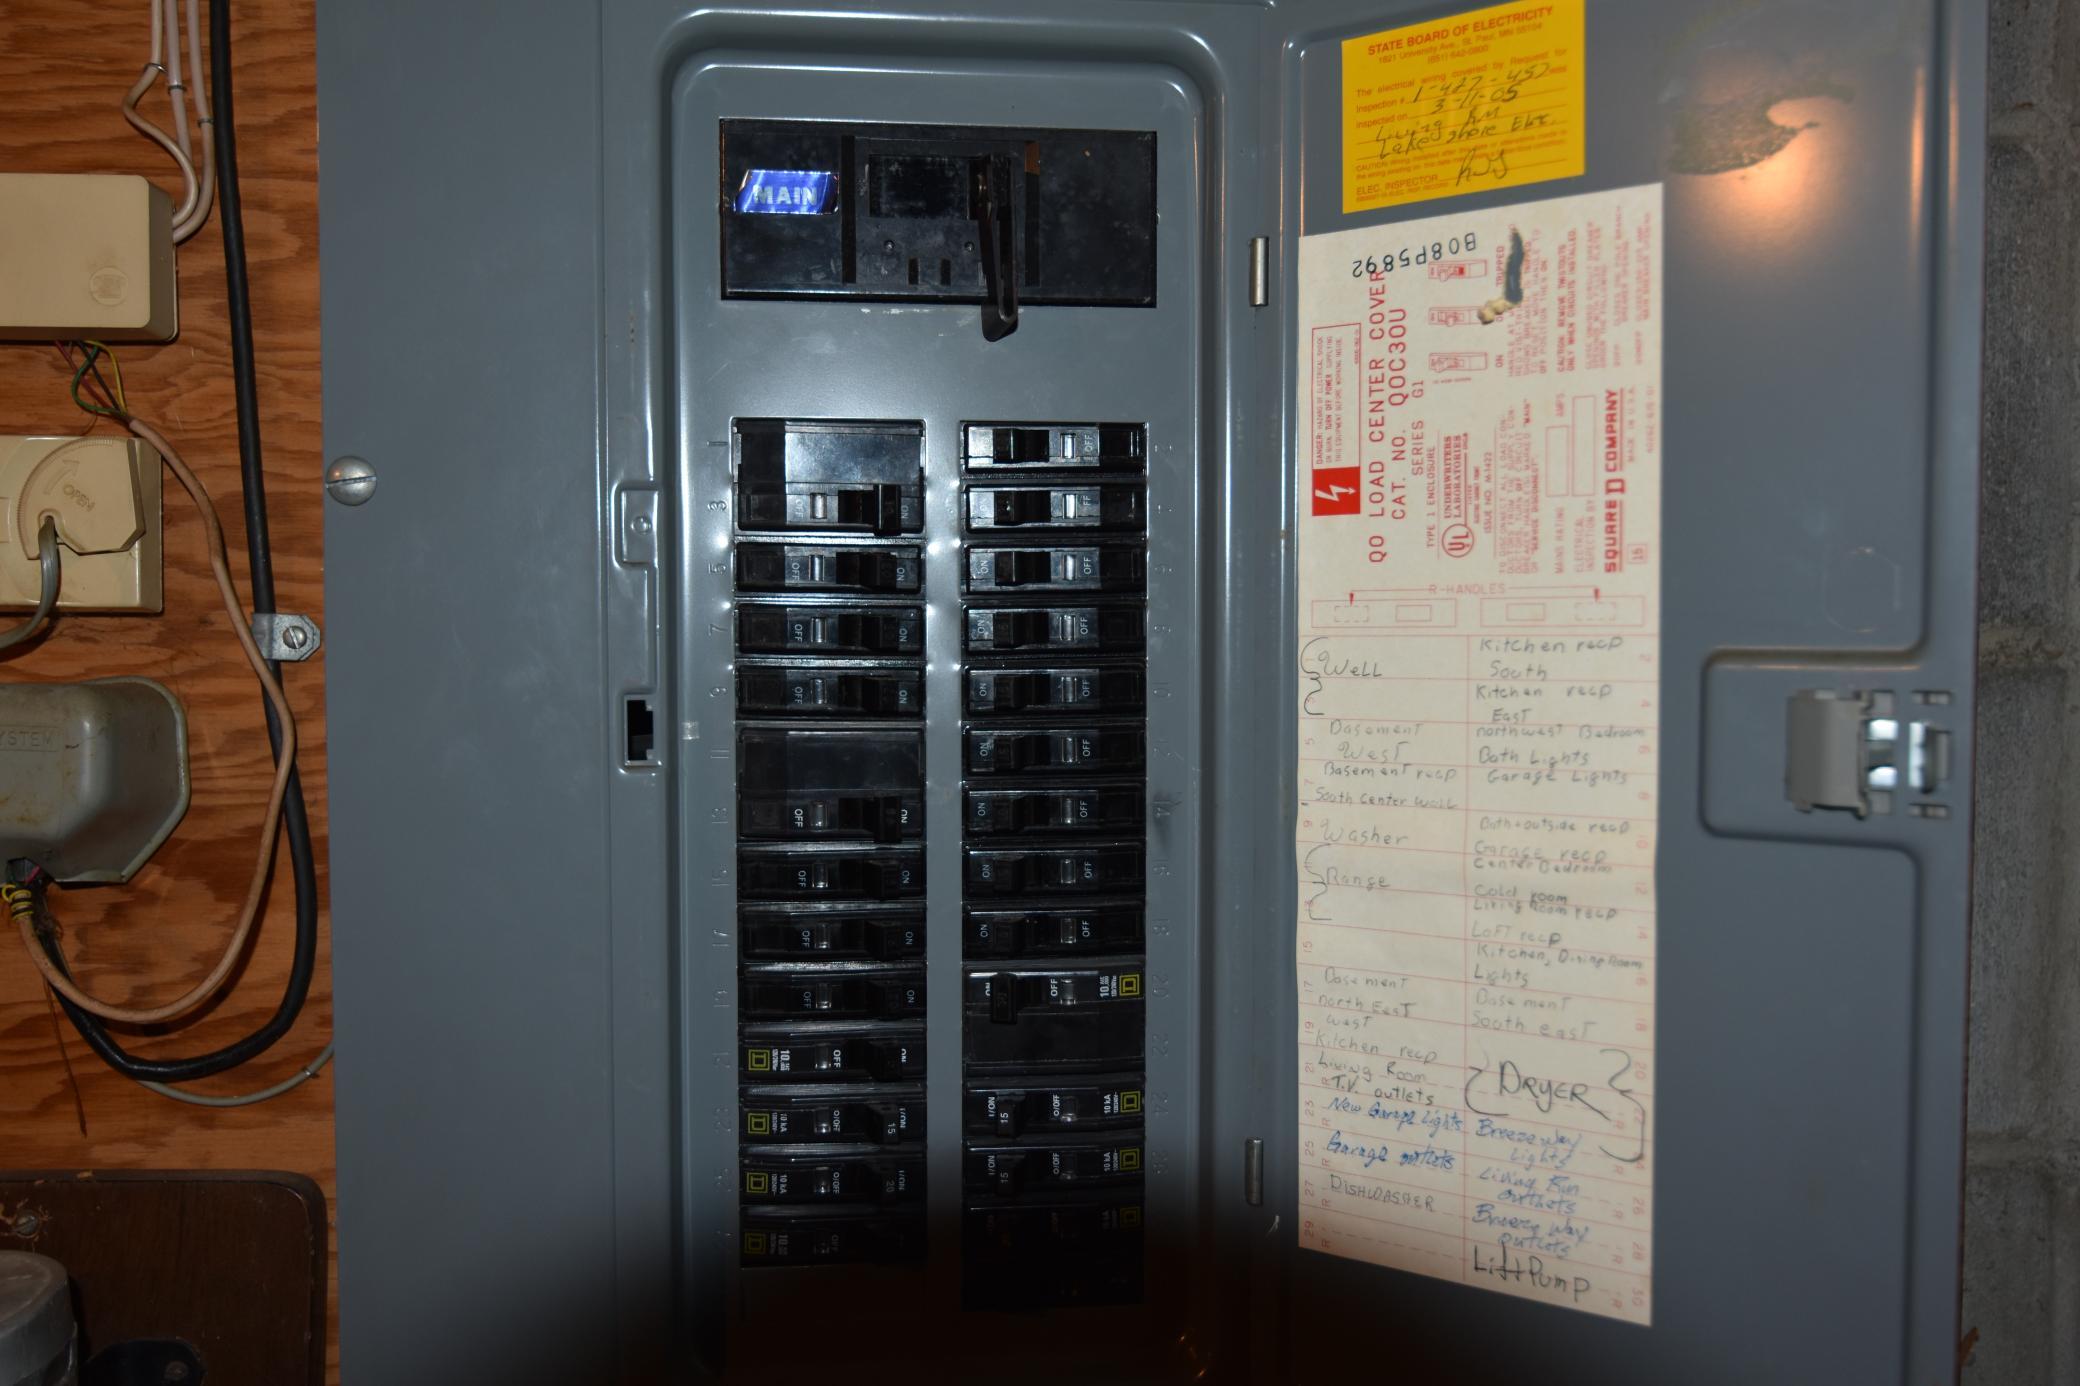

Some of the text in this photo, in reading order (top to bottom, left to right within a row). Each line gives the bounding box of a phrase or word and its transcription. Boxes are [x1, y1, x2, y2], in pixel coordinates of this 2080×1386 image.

[1367, 7, 1553, 56] STATE BOARD OF ELECTRICITY
[1357, 88, 1372, 97] The
[1378, 80, 1415, 93] electrical
[1420, 74, 1446, 84] wiring
[1452, 65, 1487, 78] covered
[1492, 62, 1503, 71] by
[1356, 99, 1397, 113] Inspection
[1385, 175, 1438, 189] INSPECTOR
[752, 183, 820, 206] MAIN
[1495, 245, 1505, 287] TRIPPED
[1368, 268, 1387, 563] QO LOAD CENTER COVER
[1411, 380, 1424, 476] SERIES G1
[1391, 429, 1406, 462] NO.
[1444, 436, 1452, 519] UNDERWRITERS
[1453, 434, 1462, 518] LABORATORIES
[1604, 389, 1625, 573] SQUARE D COMPANY
[1391, 477, 1406, 520] CAT.
[1426, 446, 1435, 548] TYPE ENCLOSURE
[1484, 510, 1492, 534] ISSUE
[896, 567, 905, 582] ON
[980, 557, 1092, 575] ON OFF
[794, 623, 907, 642] OFF ON
[977, 616, 1089, 635] ON OFF
[794, 686, 907, 704] OFF ON
[980, 679, 1091, 697] ON OFF
[980, 738, 1091, 757] ON OFF
[794, 808, 908, 828] OFF ON
[978, 800, 1088, 818] ON OFF
[798, 870, 910, 888] OFF ON
[982, 861, 1093, 879] ON OFF
[1326, 866, 1391, 891] Range
[980, 920, 1091, 938] ON OFF
[802, 930, 912, 948] OFF ON
[1051, 978, 1059, 997] OFF
[804, 989, 914, 1008] OFF ON
[833, 1049, 841, 1068] OFF
[1327, 1097, 1362, 1113] New
[1000, 1112, 1008, 1124] 15
[887, 1123, 896, 1135] 15
[1326, 1130, 1388, 1168] Garage
[1000, 1172, 1008, 1183] 15
